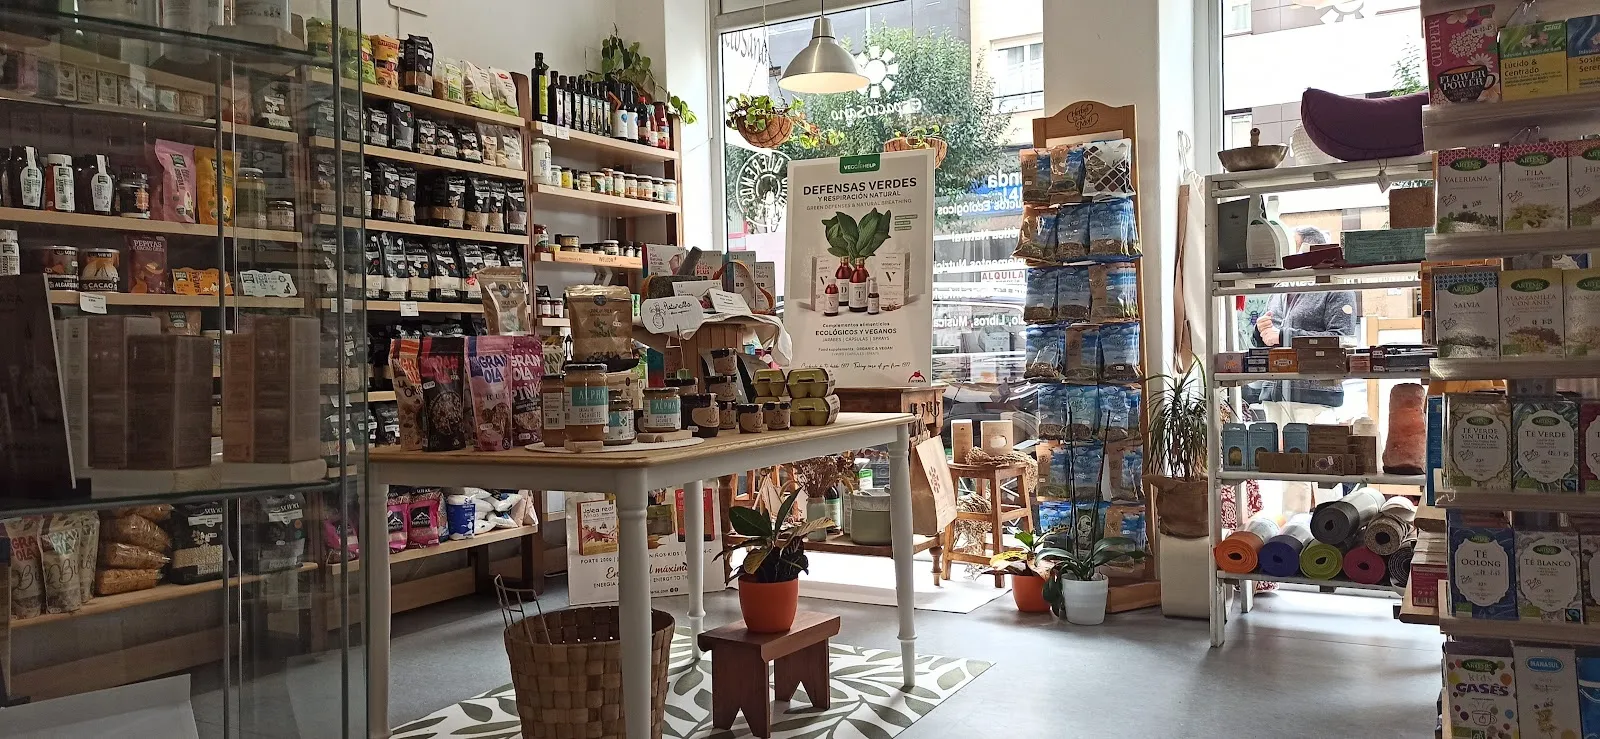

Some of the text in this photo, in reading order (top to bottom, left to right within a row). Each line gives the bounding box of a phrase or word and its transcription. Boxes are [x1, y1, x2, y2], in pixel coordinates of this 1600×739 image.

[1429, 19, 1443, 67] CUPPER
[1504, 59, 1529, 70] Lúcido
[1578, 56, 1600, 65] Sosie
[1439, 69, 1486, 85] FLOWER
[1504, 67, 1540, 78] Centrado
[1443, 78, 1484, 92] POWER
[1525, 169, 1544, 177] TILA
[1444, 175, 1489, 184] VALERIANA
[803, 181, 866, 196] DEFENSAS
[868, 177, 917, 190] VERDES
[823, 192, 869, 202] RESPIRACIÓN
[869, 190, 901, 199] NATURAL
[982, 271, 1024, 281] ALQUILA
[88, 282, 113, 290] CACAO
[815, 328, 858, 336] ECOLÓGICOS
[479, 353, 508, 368] GRAN
[483, 365, 505, 384] OLA
[578, 387, 605, 400] ALPHA
[655, 402, 676, 410] ALPHA
[601, 504, 614, 512] real
[1461, 558, 1501, 567] OOLONG
[1537, 559, 1571, 567] BLANCO
[654, 563, 688, 574] máxim
[1530, 660, 1559, 669] MANASUL
[1456, 682, 1510, 697] GASES
